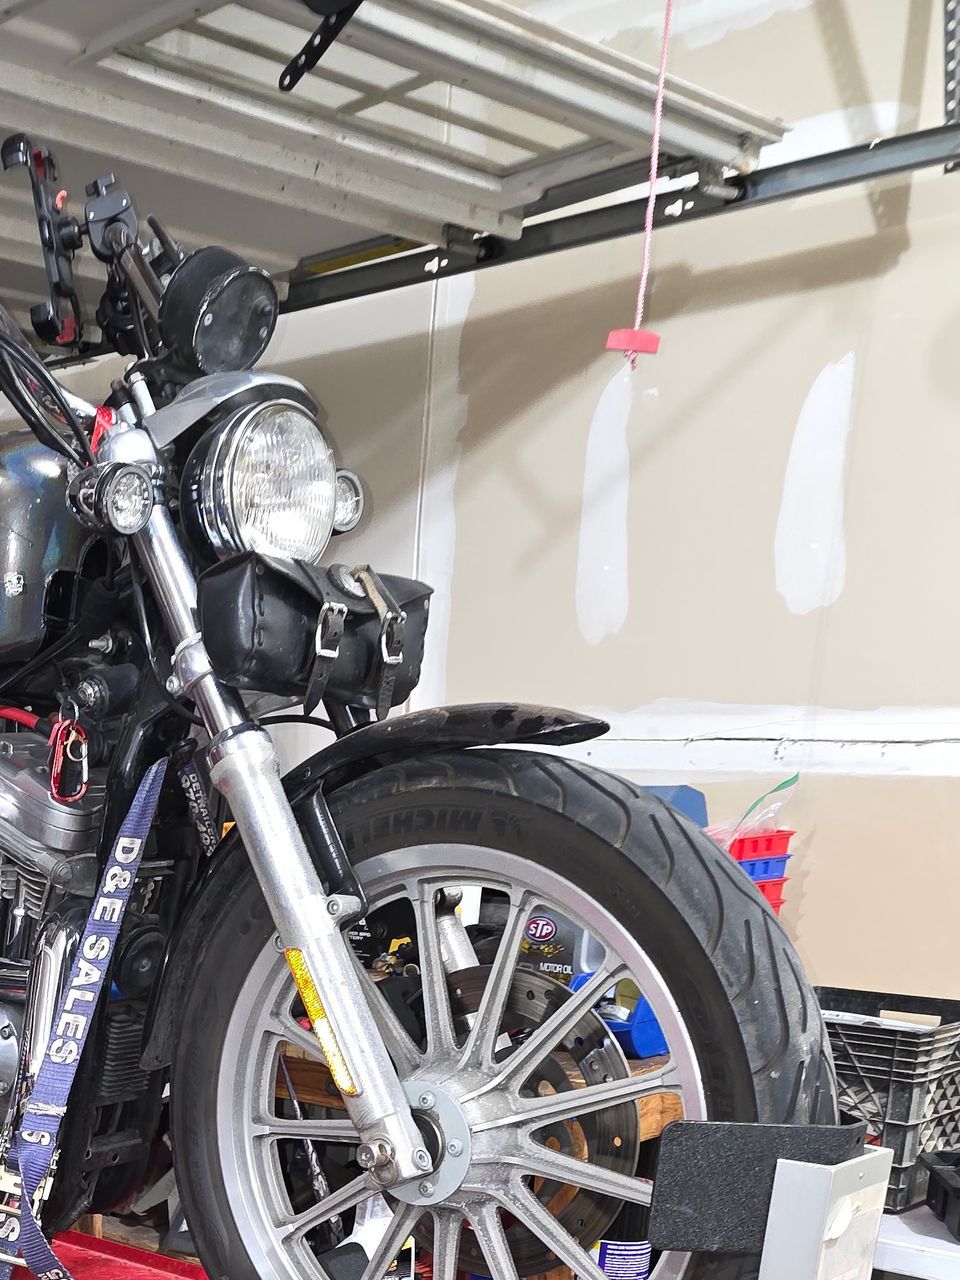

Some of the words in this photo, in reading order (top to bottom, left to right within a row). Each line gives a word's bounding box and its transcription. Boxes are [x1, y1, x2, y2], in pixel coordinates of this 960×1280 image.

[93, 837, 143, 922] D&E
[528, 920, 553, 937] STP
[540, 962, 563, 974] MOTOR
[563, 964, 574, 975] OIL
[49, 934, 111, 1065] SALES
